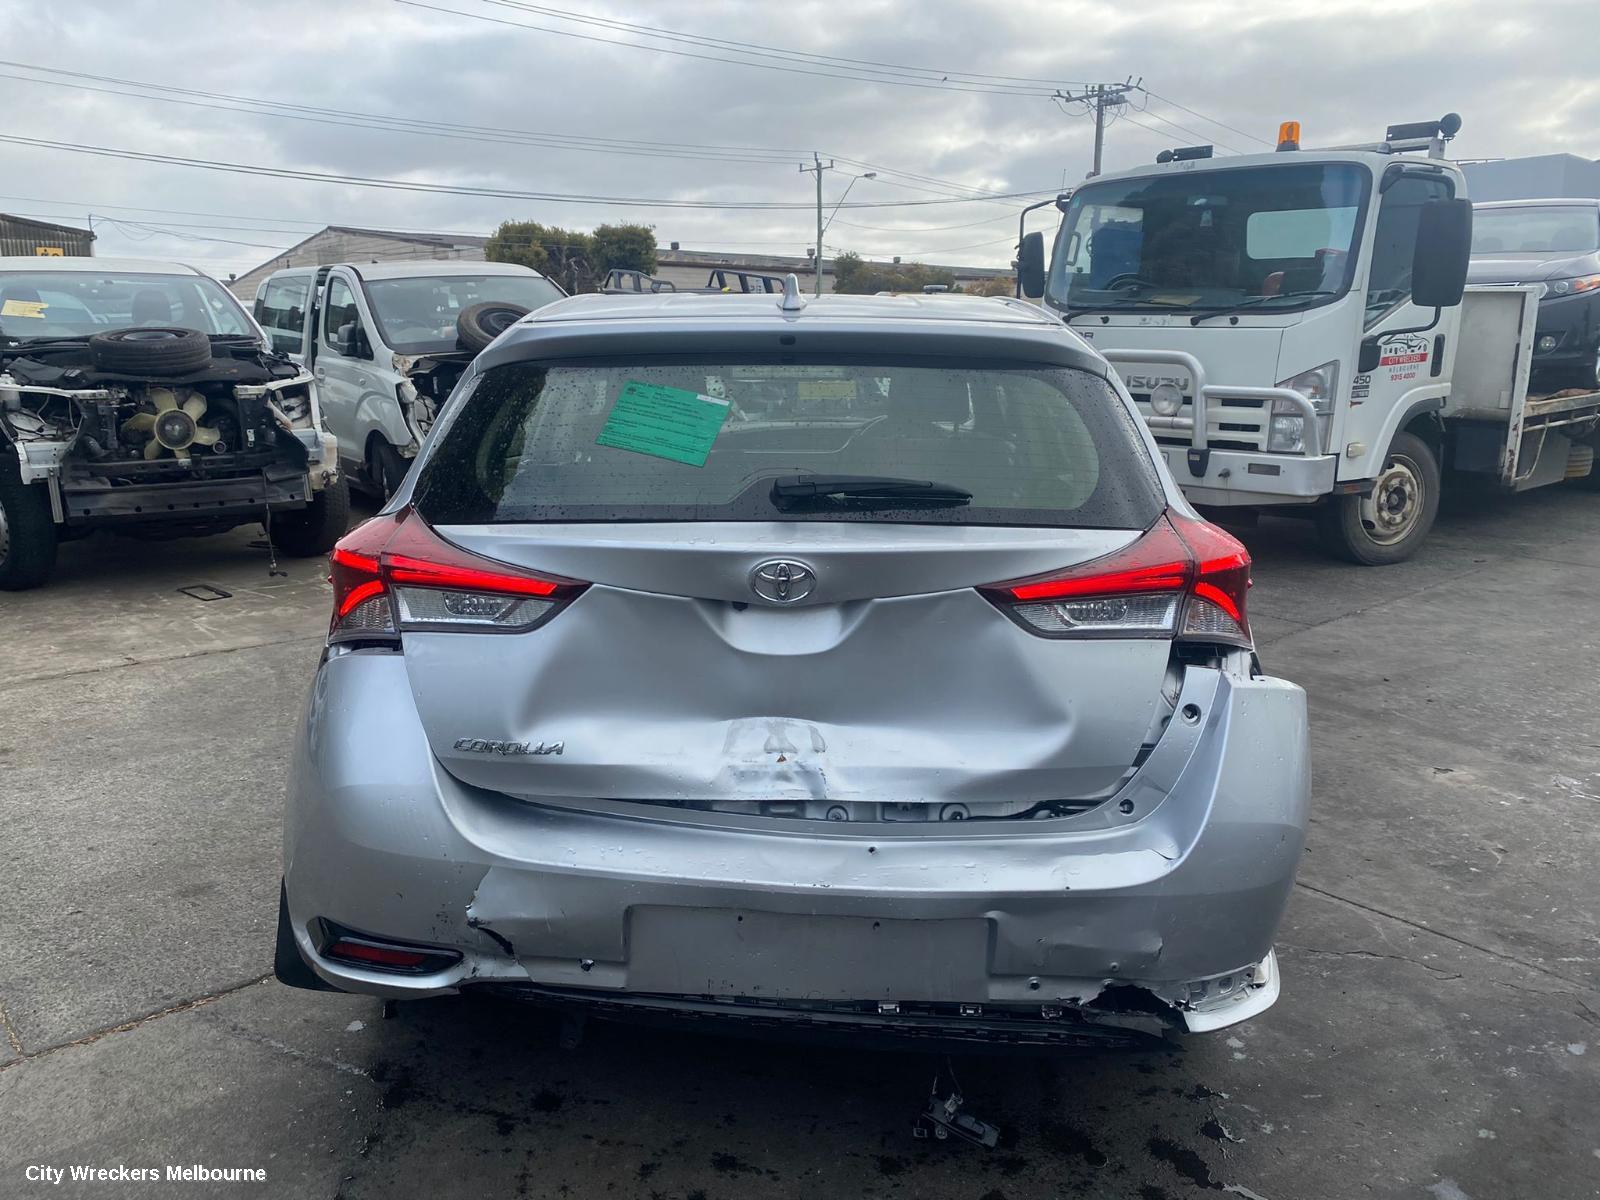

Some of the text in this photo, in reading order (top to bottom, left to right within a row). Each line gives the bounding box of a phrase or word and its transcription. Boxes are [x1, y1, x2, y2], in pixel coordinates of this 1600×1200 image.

[1126, 375, 1189, 391] ISUZU
[1353, 375, 1371, 384] 450
[454, 738, 564, 755] COROLLA
